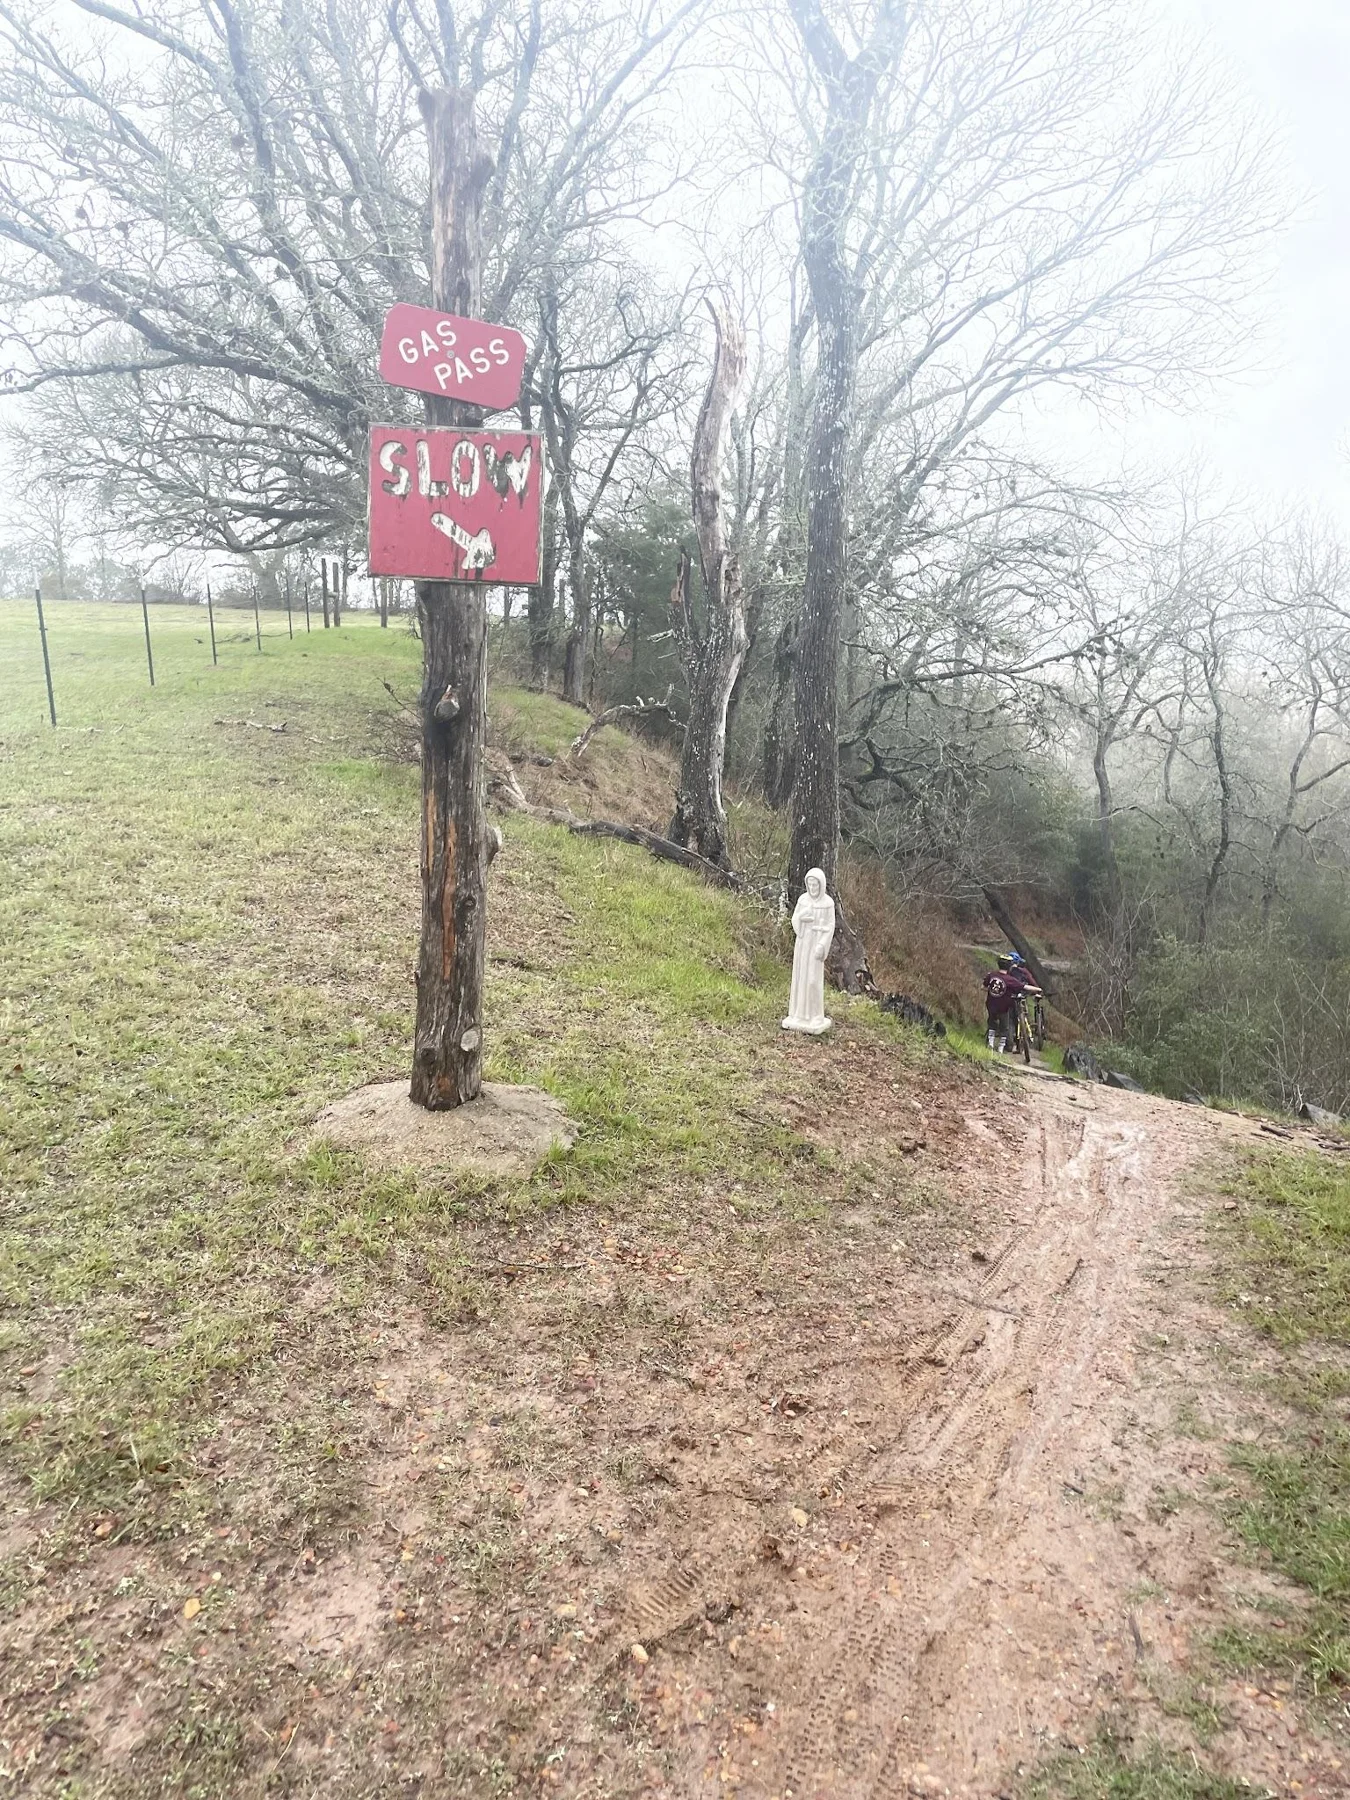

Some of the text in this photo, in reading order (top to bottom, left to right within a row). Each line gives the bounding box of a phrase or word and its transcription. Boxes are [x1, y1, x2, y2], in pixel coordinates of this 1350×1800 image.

[398, 320, 457, 364] GAS
[433, 338, 510, 390] PASS
[379, 439, 533, 499] SLOW
